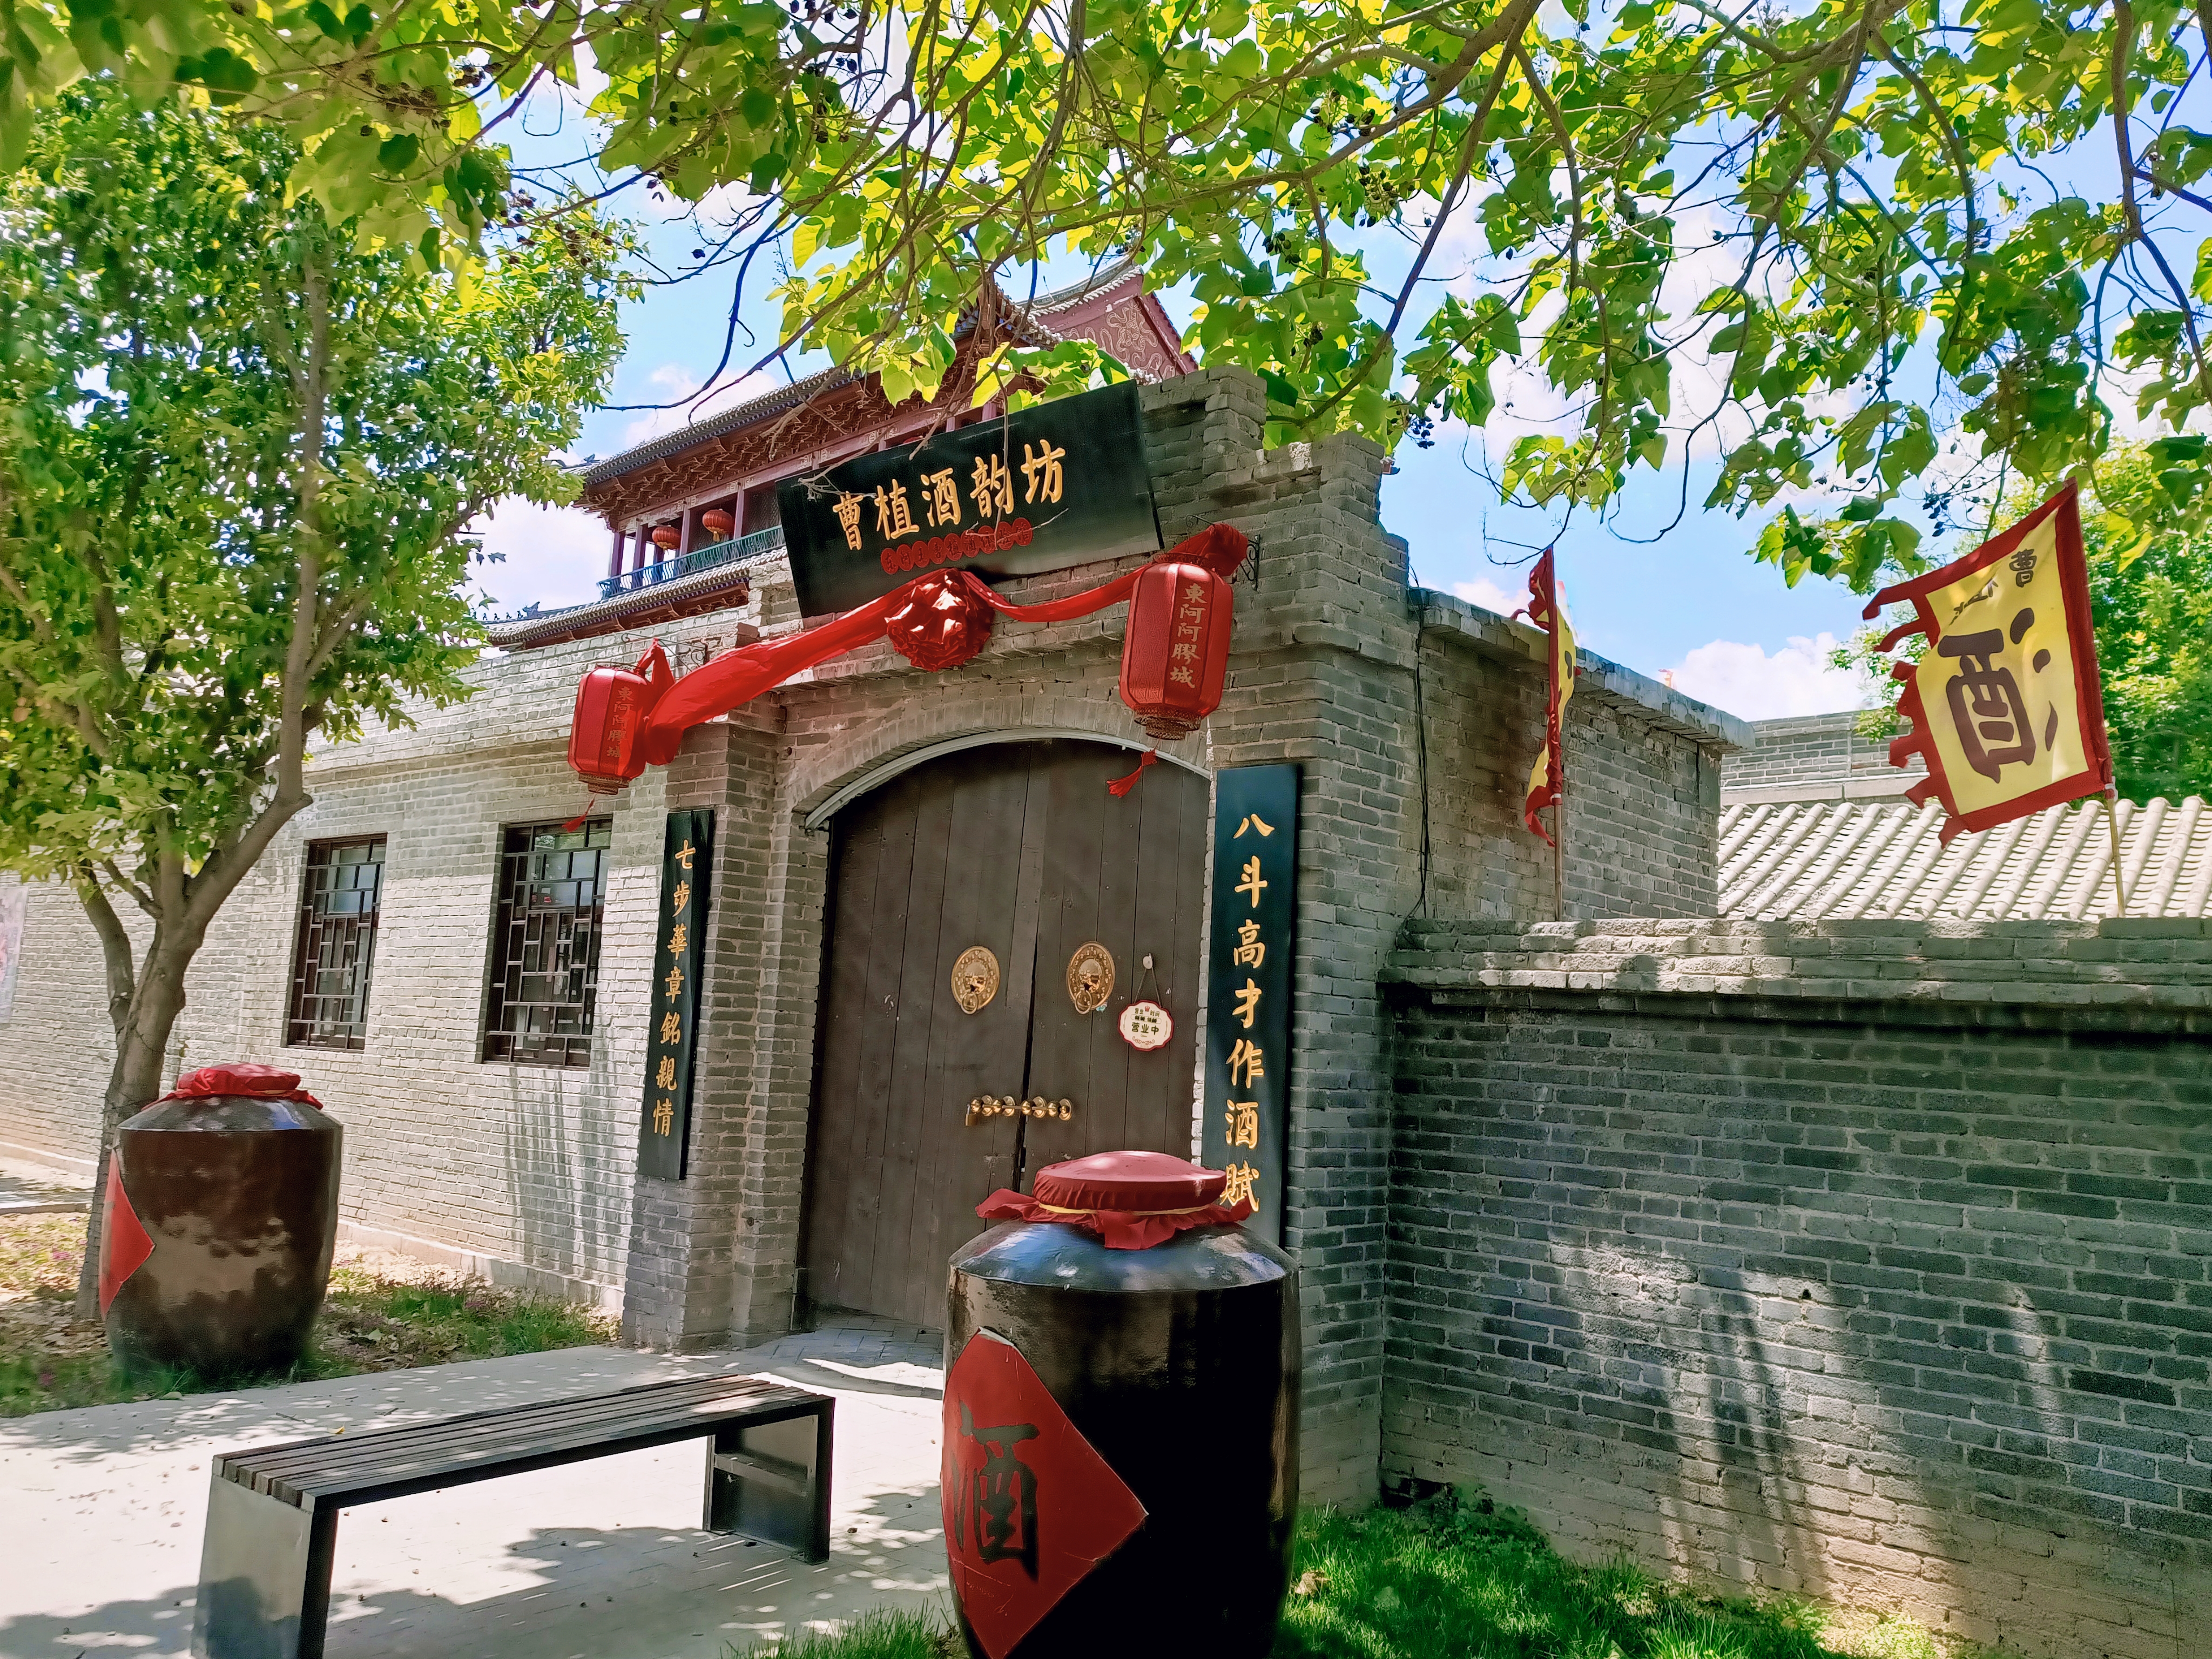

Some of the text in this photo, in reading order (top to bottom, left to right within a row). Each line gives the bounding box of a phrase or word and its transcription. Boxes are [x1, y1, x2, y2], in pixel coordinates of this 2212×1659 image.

[833, 439, 1067, 551] 曹植酒韵坊
[1170, 583, 1207, 689] 東阿阿膠城
[1131, 1022, 1159, 1035] 营业中
[1220, 812, 1275, 1212] 八斗高才作酒賦
[951, 1399, 1041, 1583] 酒
